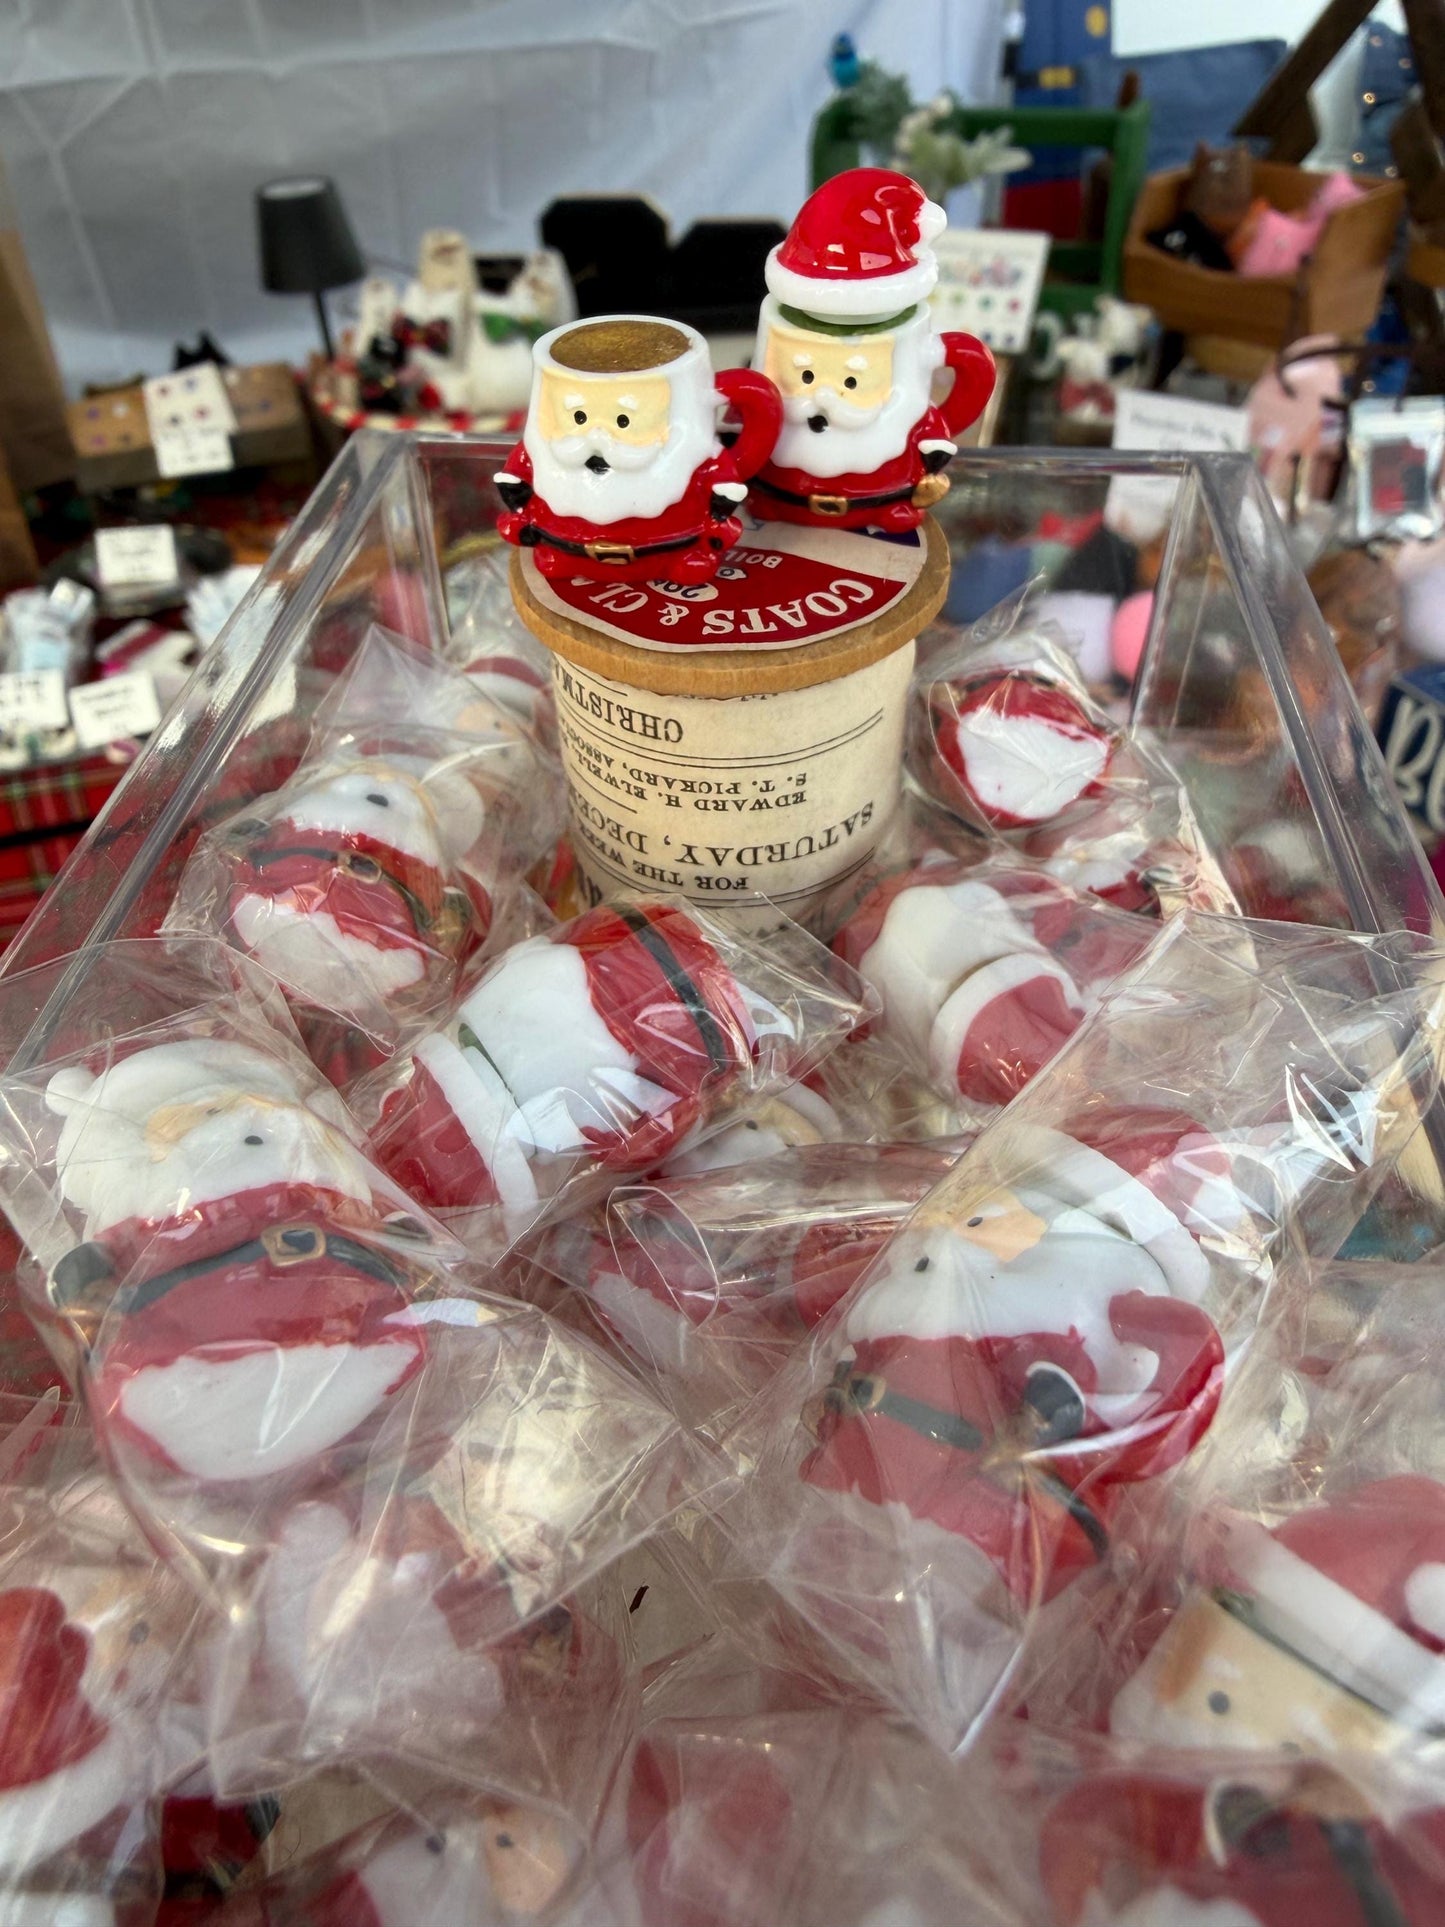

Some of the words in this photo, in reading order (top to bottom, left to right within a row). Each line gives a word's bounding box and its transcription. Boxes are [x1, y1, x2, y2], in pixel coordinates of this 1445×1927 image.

[657, 601, 689, 626] &
[701, 577, 874, 635] COATS
[622, 763, 740, 795] PICKARD,
[752, 780, 775, 793] T.
[786, 772, 807, 787] S.
[657, 792, 682, 808] H.
[694, 790, 807, 812] EDWARD
[663, 801, 873, 867] SATURDAY,
[633, 859, 683, 886] THE
[694, 876, 748, 890] FOR
